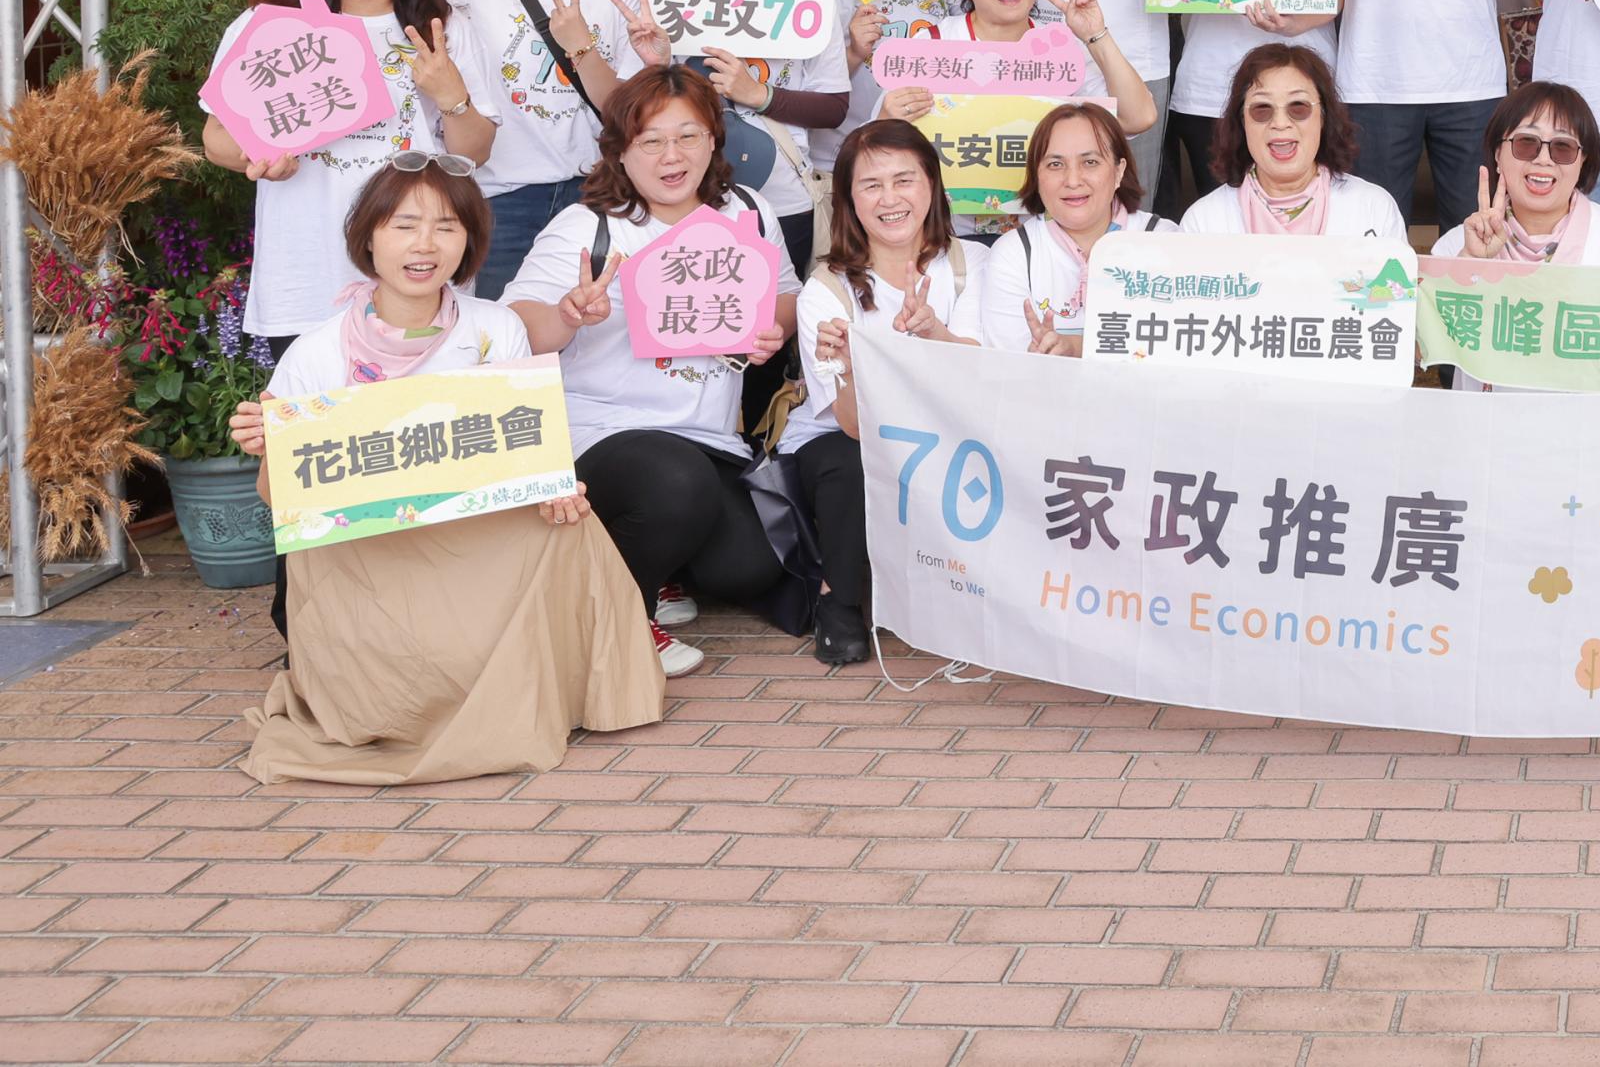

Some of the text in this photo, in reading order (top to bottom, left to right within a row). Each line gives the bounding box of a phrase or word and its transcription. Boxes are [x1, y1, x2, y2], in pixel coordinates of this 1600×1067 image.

[239, 32, 337, 92] 家政
[883, 55, 1078, 83] 傳承美好 幸福時光
[264, 76, 357, 139] 最美
[661, 246, 746, 285] 家政
[1124, 272, 1249, 301] 綠色照顧站
[657, 294, 744, 335] 最美
[1095, 311, 1403, 361] 臺中市外埔區農會
[293, 405, 545, 489] 花壇鄉農會
[878, 425, 1004, 542] 70
[1044, 456, 1468, 591] 家政推廣
[916, 549, 967, 575] from Me
[951, 578, 985, 598] to We
[1040, 571, 1451, 656] Home Economics
